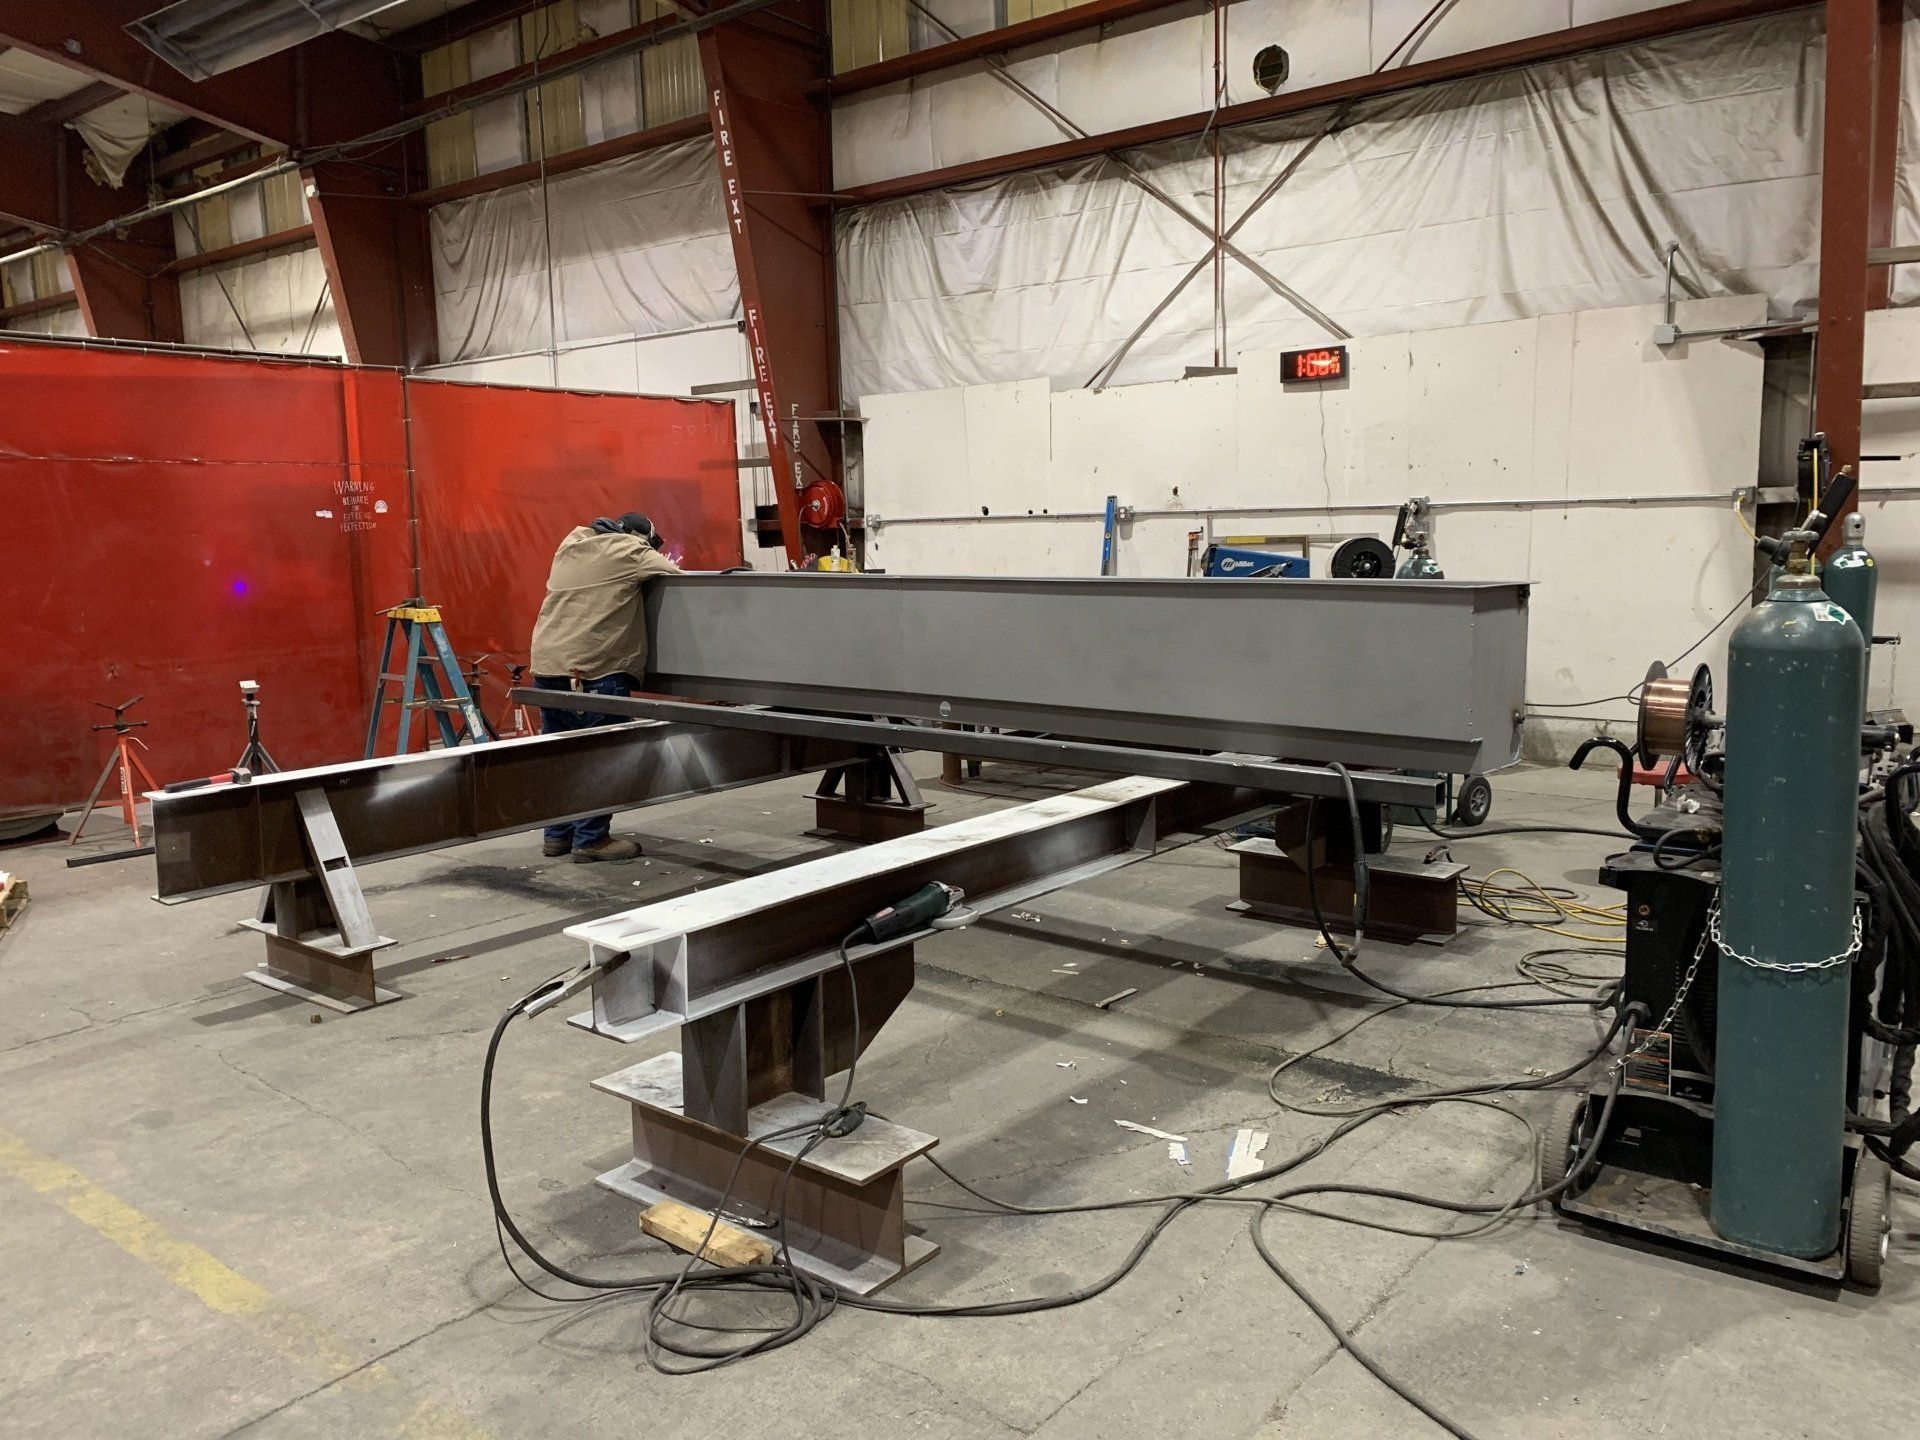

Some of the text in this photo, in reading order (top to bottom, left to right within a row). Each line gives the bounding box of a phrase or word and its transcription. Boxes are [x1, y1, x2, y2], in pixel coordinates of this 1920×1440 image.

[713, 89, 742, 234] FIRE EXT
[748, 309, 777, 446] FIRE EXT
[791, 403, 800, 453] FIRE
[333, 480, 374, 495] WARNING
[342, 496, 368, 505] BEWARE
